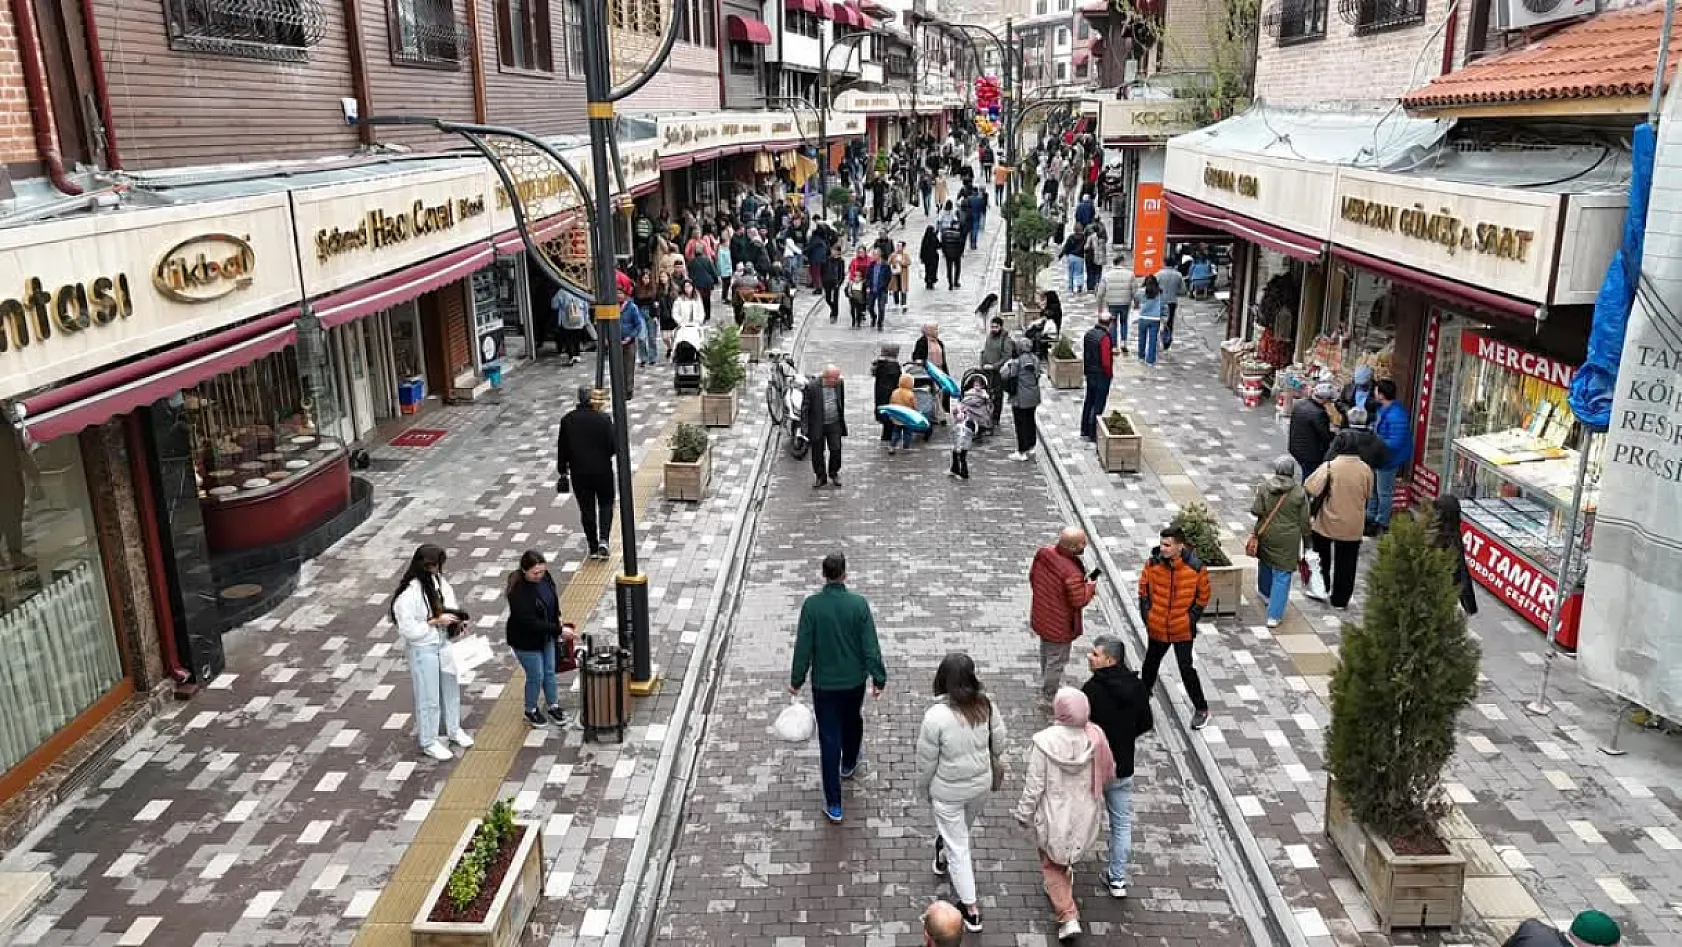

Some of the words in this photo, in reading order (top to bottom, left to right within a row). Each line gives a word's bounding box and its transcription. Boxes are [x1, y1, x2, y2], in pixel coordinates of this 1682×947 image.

[1341, 195, 1399, 234] MERCAN
[1475, 220, 1534, 263] SAAT
[1477, 336, 1572, 388] MERCAN
[1464, 553, 1504, 589] ORDON
